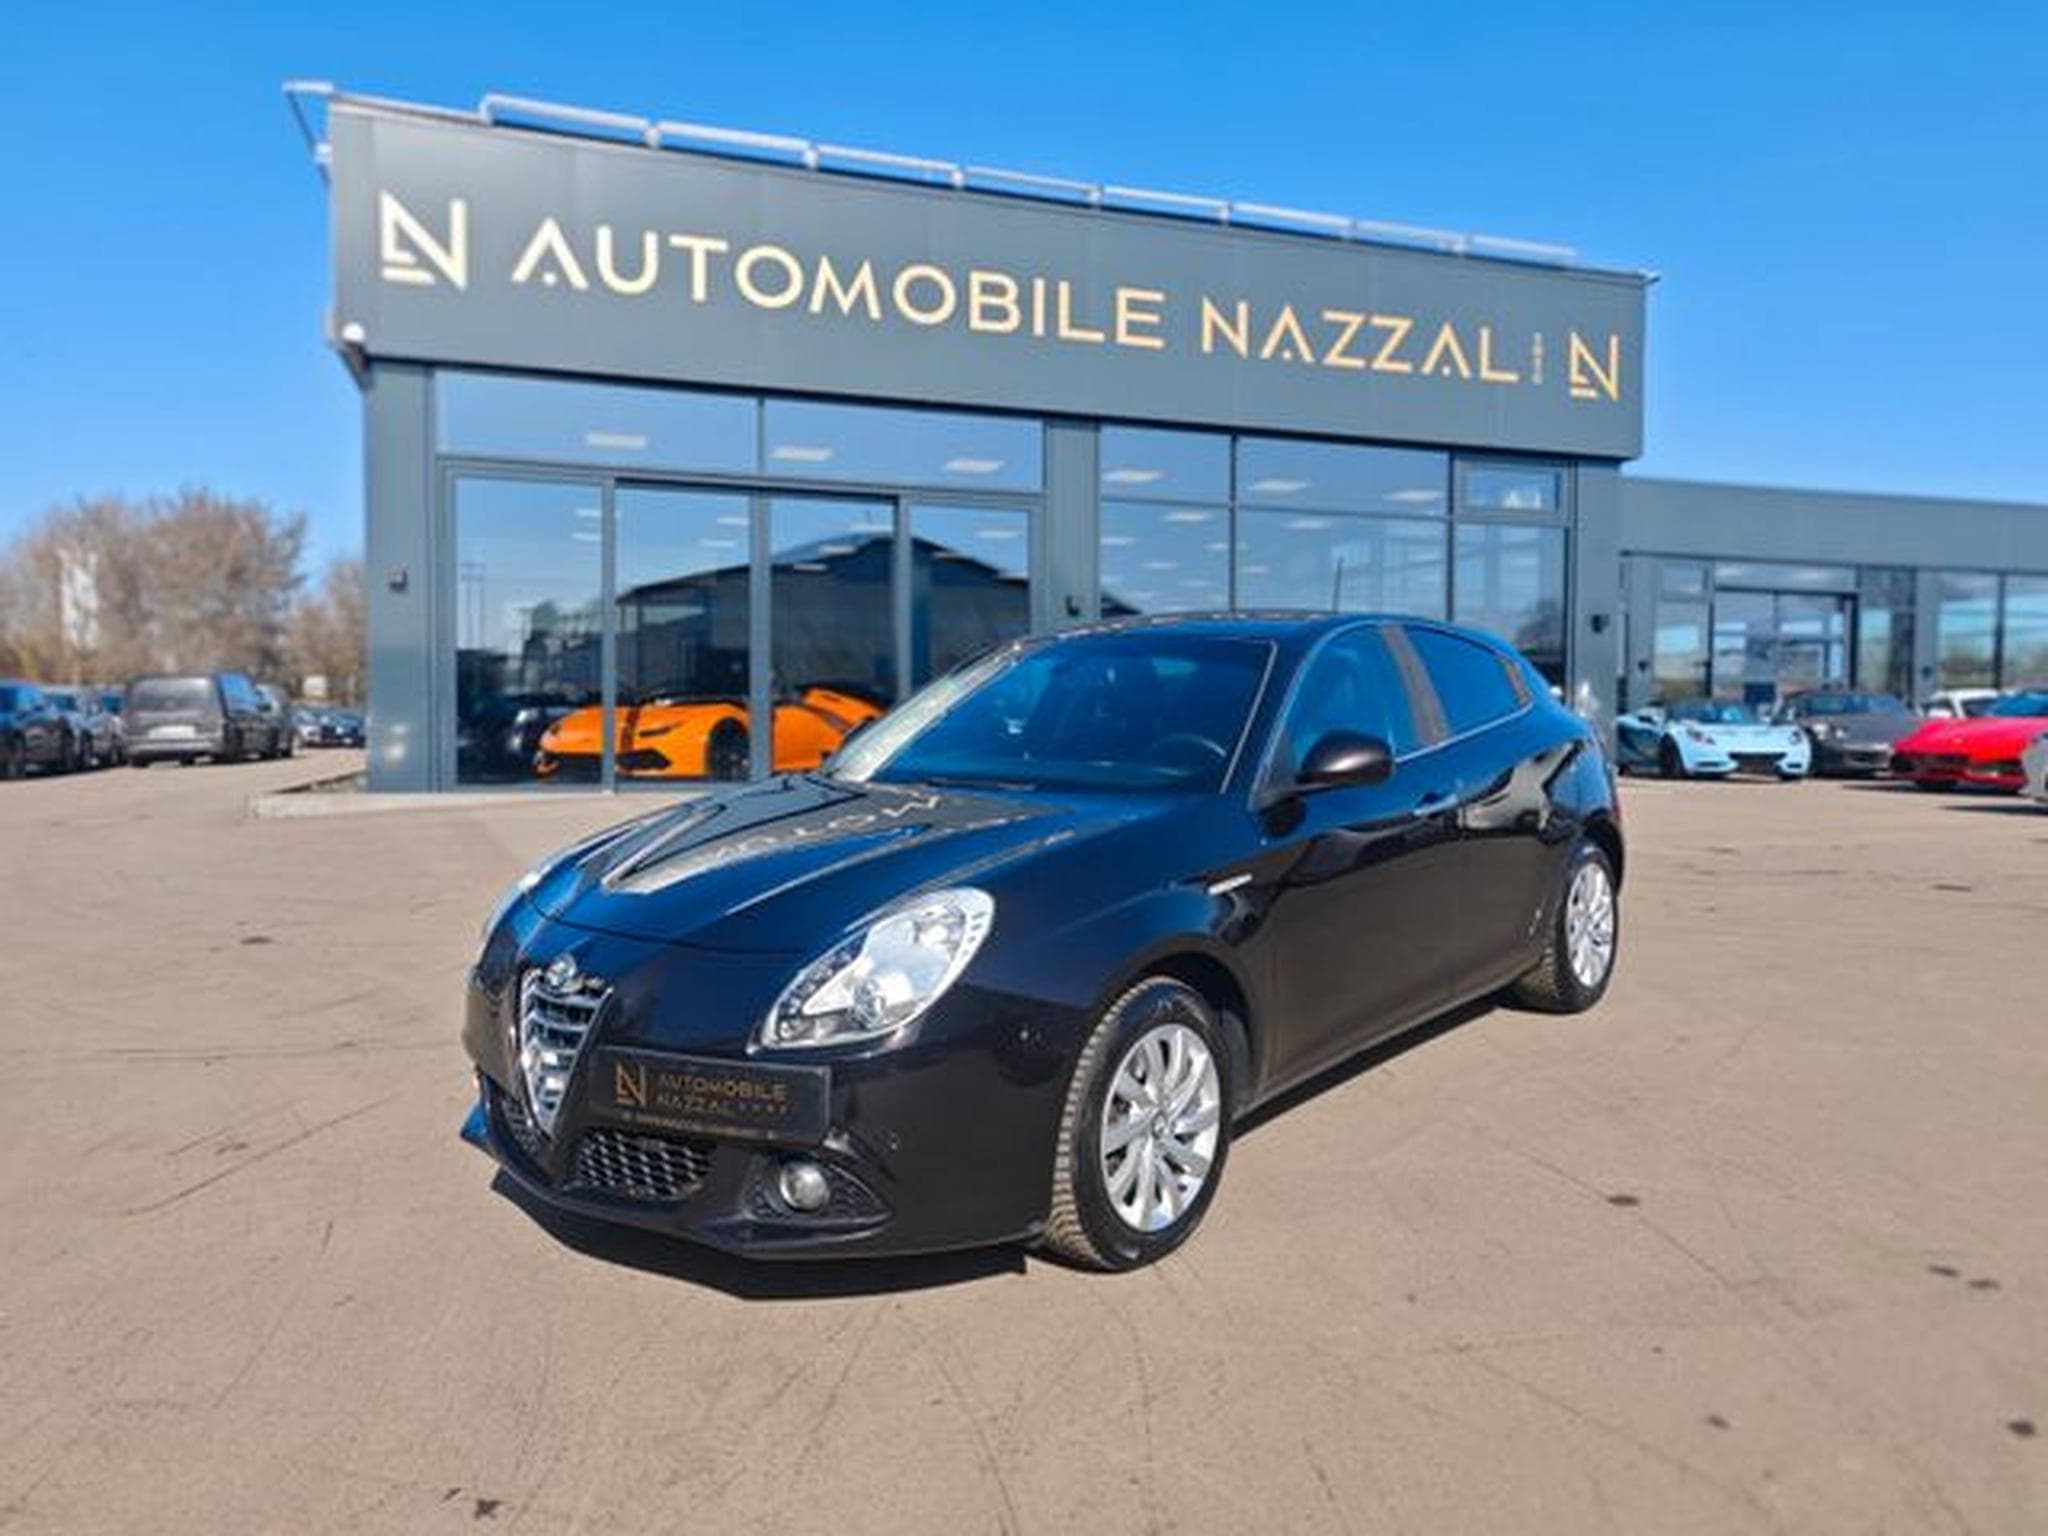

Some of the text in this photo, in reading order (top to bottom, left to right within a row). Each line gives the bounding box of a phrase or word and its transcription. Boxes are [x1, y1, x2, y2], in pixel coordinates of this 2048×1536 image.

[511, 218, 1166, 349] AUTOMOBILE
[1201, 297, 1519, 383] NAZZAL
[660, 1074, 787, 1100] AUTOMOBILE
